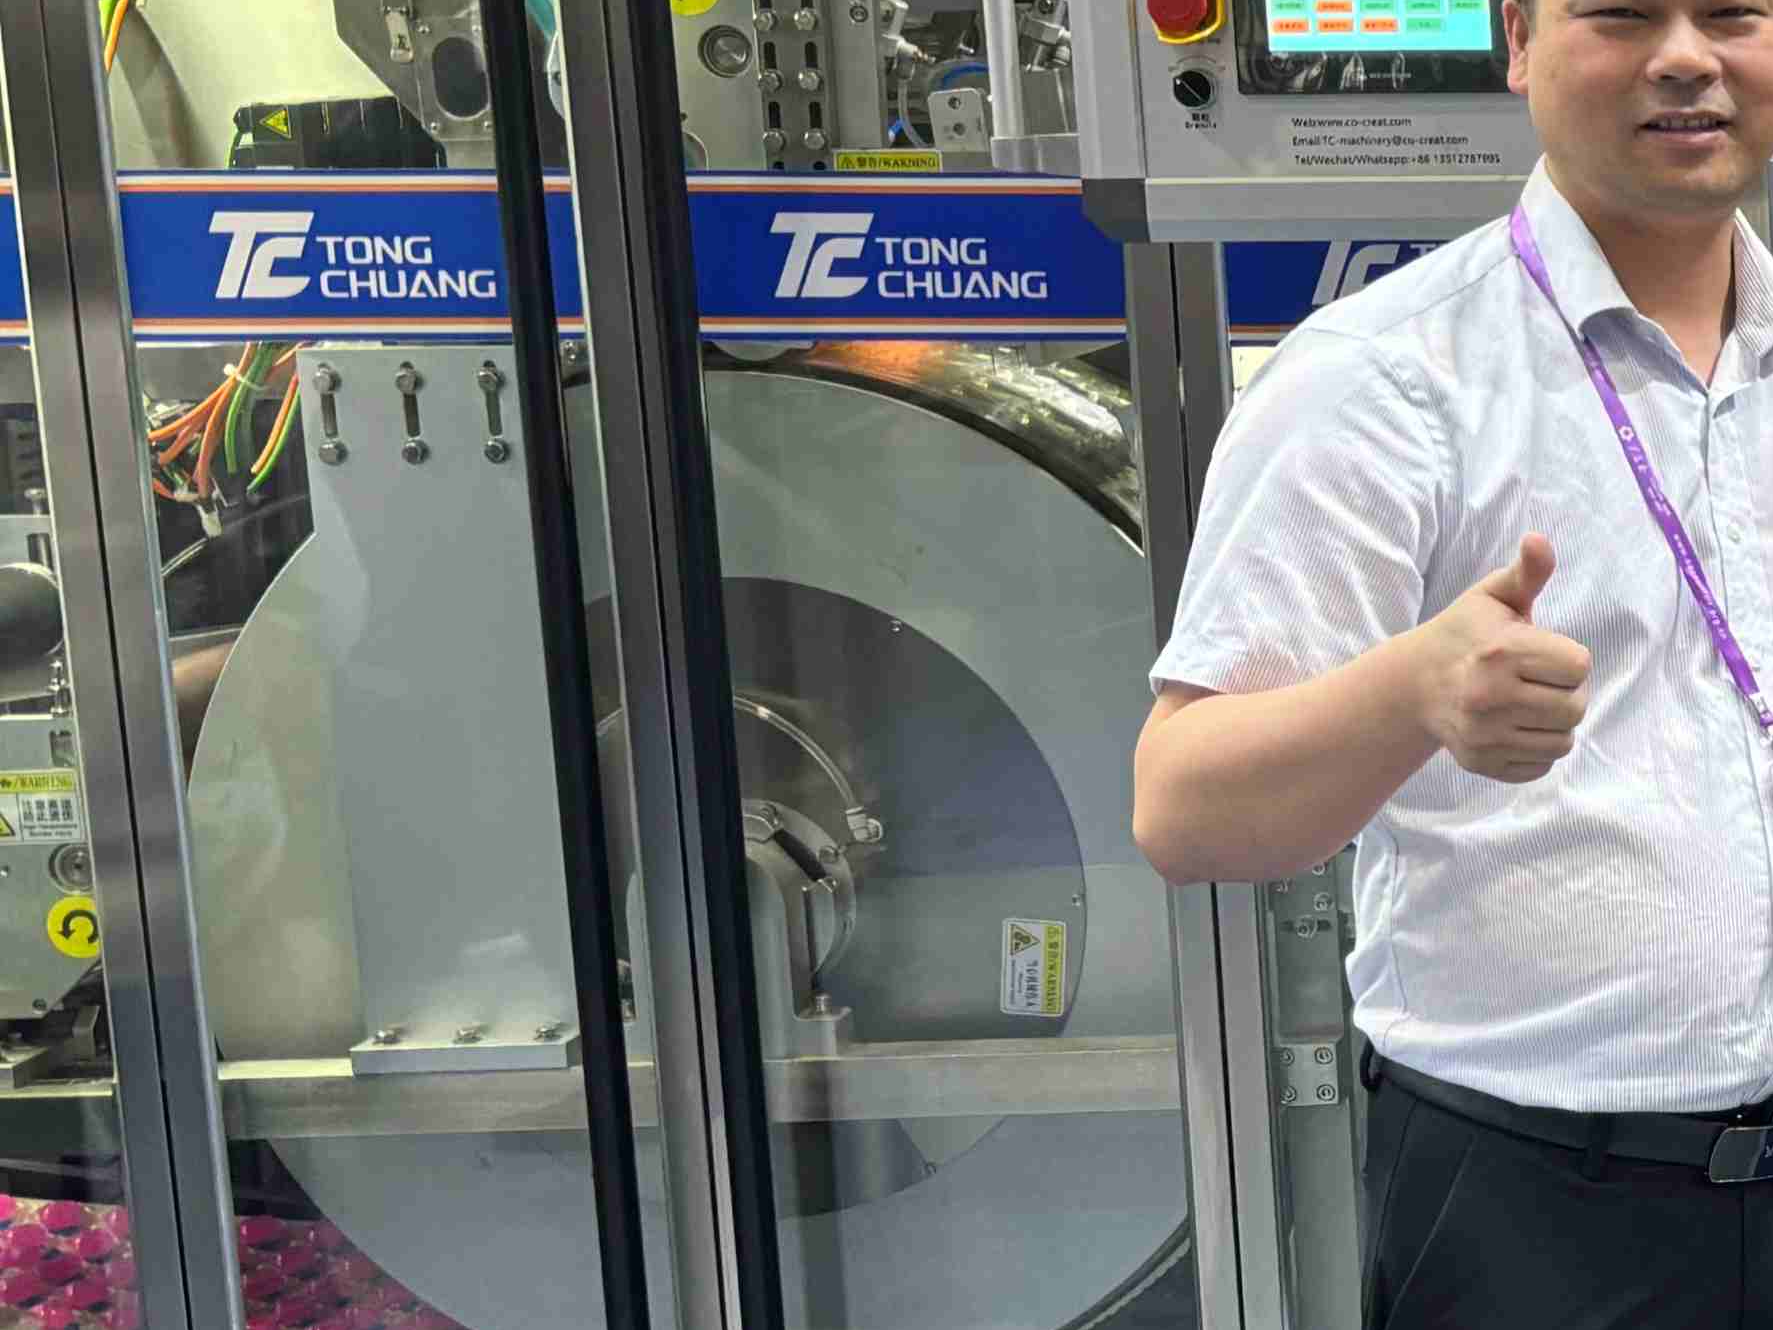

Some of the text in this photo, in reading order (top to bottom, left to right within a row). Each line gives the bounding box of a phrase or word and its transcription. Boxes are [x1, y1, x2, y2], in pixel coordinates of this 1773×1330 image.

[208, 211, 314, 299] TC
[317, 235, 433, 265] TONG
[770, 212, 875, 298] TC
[875, 237, 988, 265] TONG
[320, 270, 497, 299] CHUANG
[877, 271, 1049, 299] CHUANG
